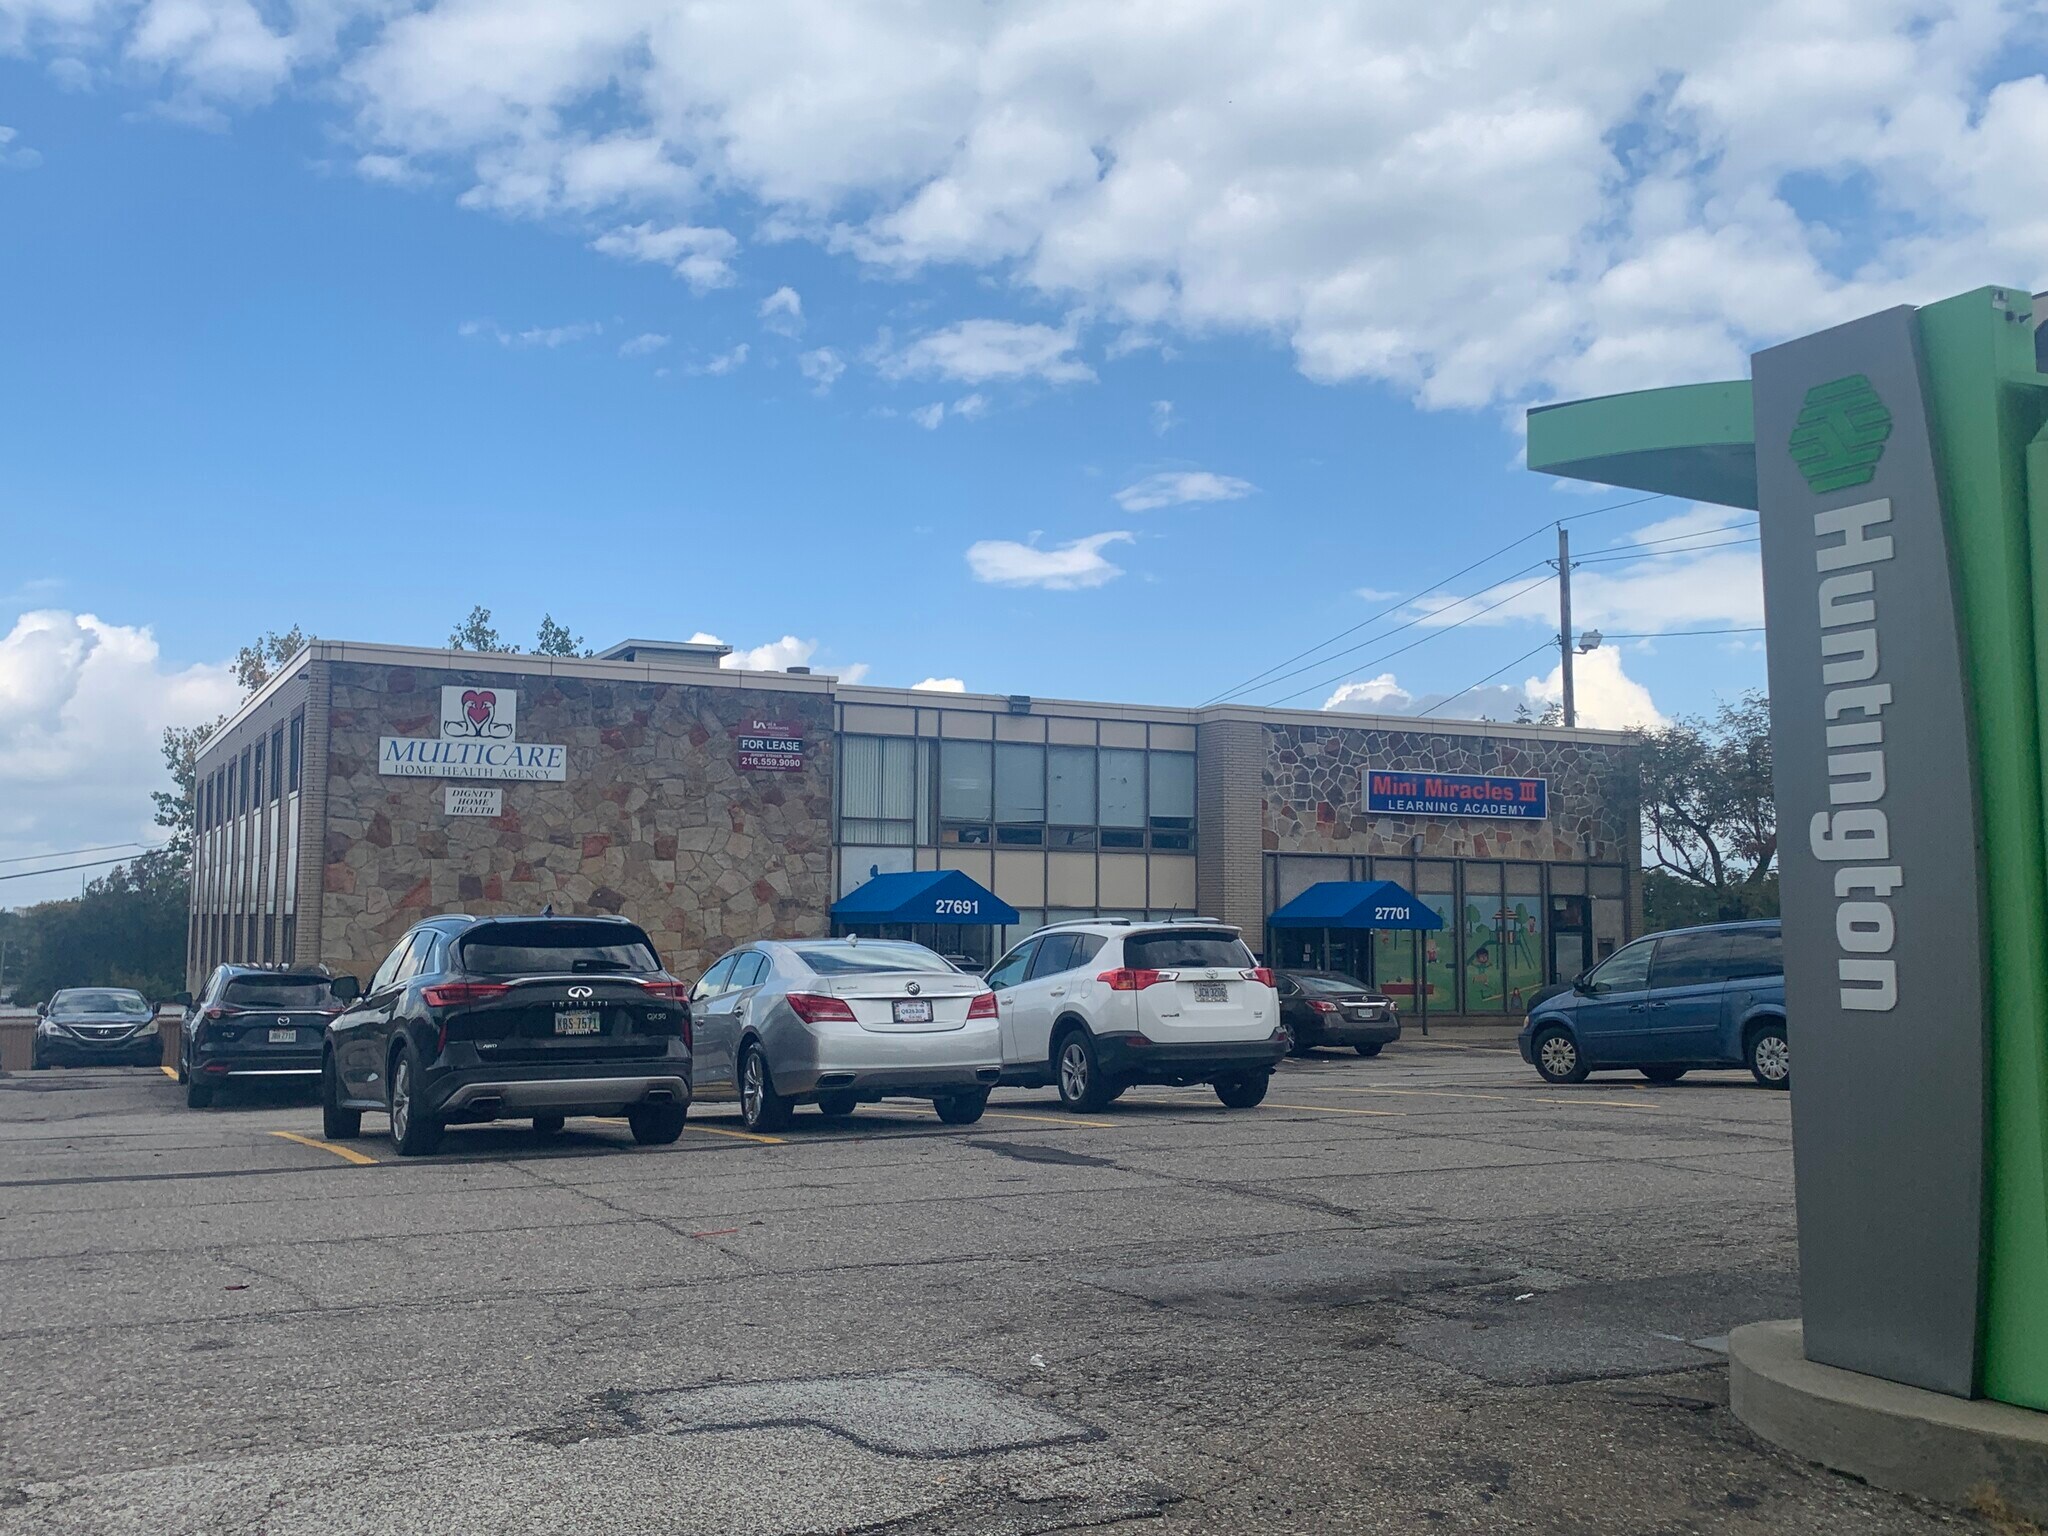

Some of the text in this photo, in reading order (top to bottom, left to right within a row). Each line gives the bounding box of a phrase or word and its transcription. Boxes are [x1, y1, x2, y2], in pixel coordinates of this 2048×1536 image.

[742, 739, 800, 751] FOR LEASE
[384, 740, 564, 768] MULTICARE
[1809, 497, 1903, 1012] Huntington
[741, 757, 801, 767] 216.559.9090
[395, 765, 552, 780] HOME HEALTH AGENCY
[451, 789, 496, 799] DIGNITY
[1373, 775, 1538, 802] Mini Miracles III
[457, 798, 489, 807] HOME
[1388, 800, 1527, 816] LEARNING ACADEMY
[451, 806, 495, 815] HEALTH
[935, 899, 979, 915] 27691
[1375, 907, 1410, 920] 27701
[577, 1018, 599, 1030] 7571
